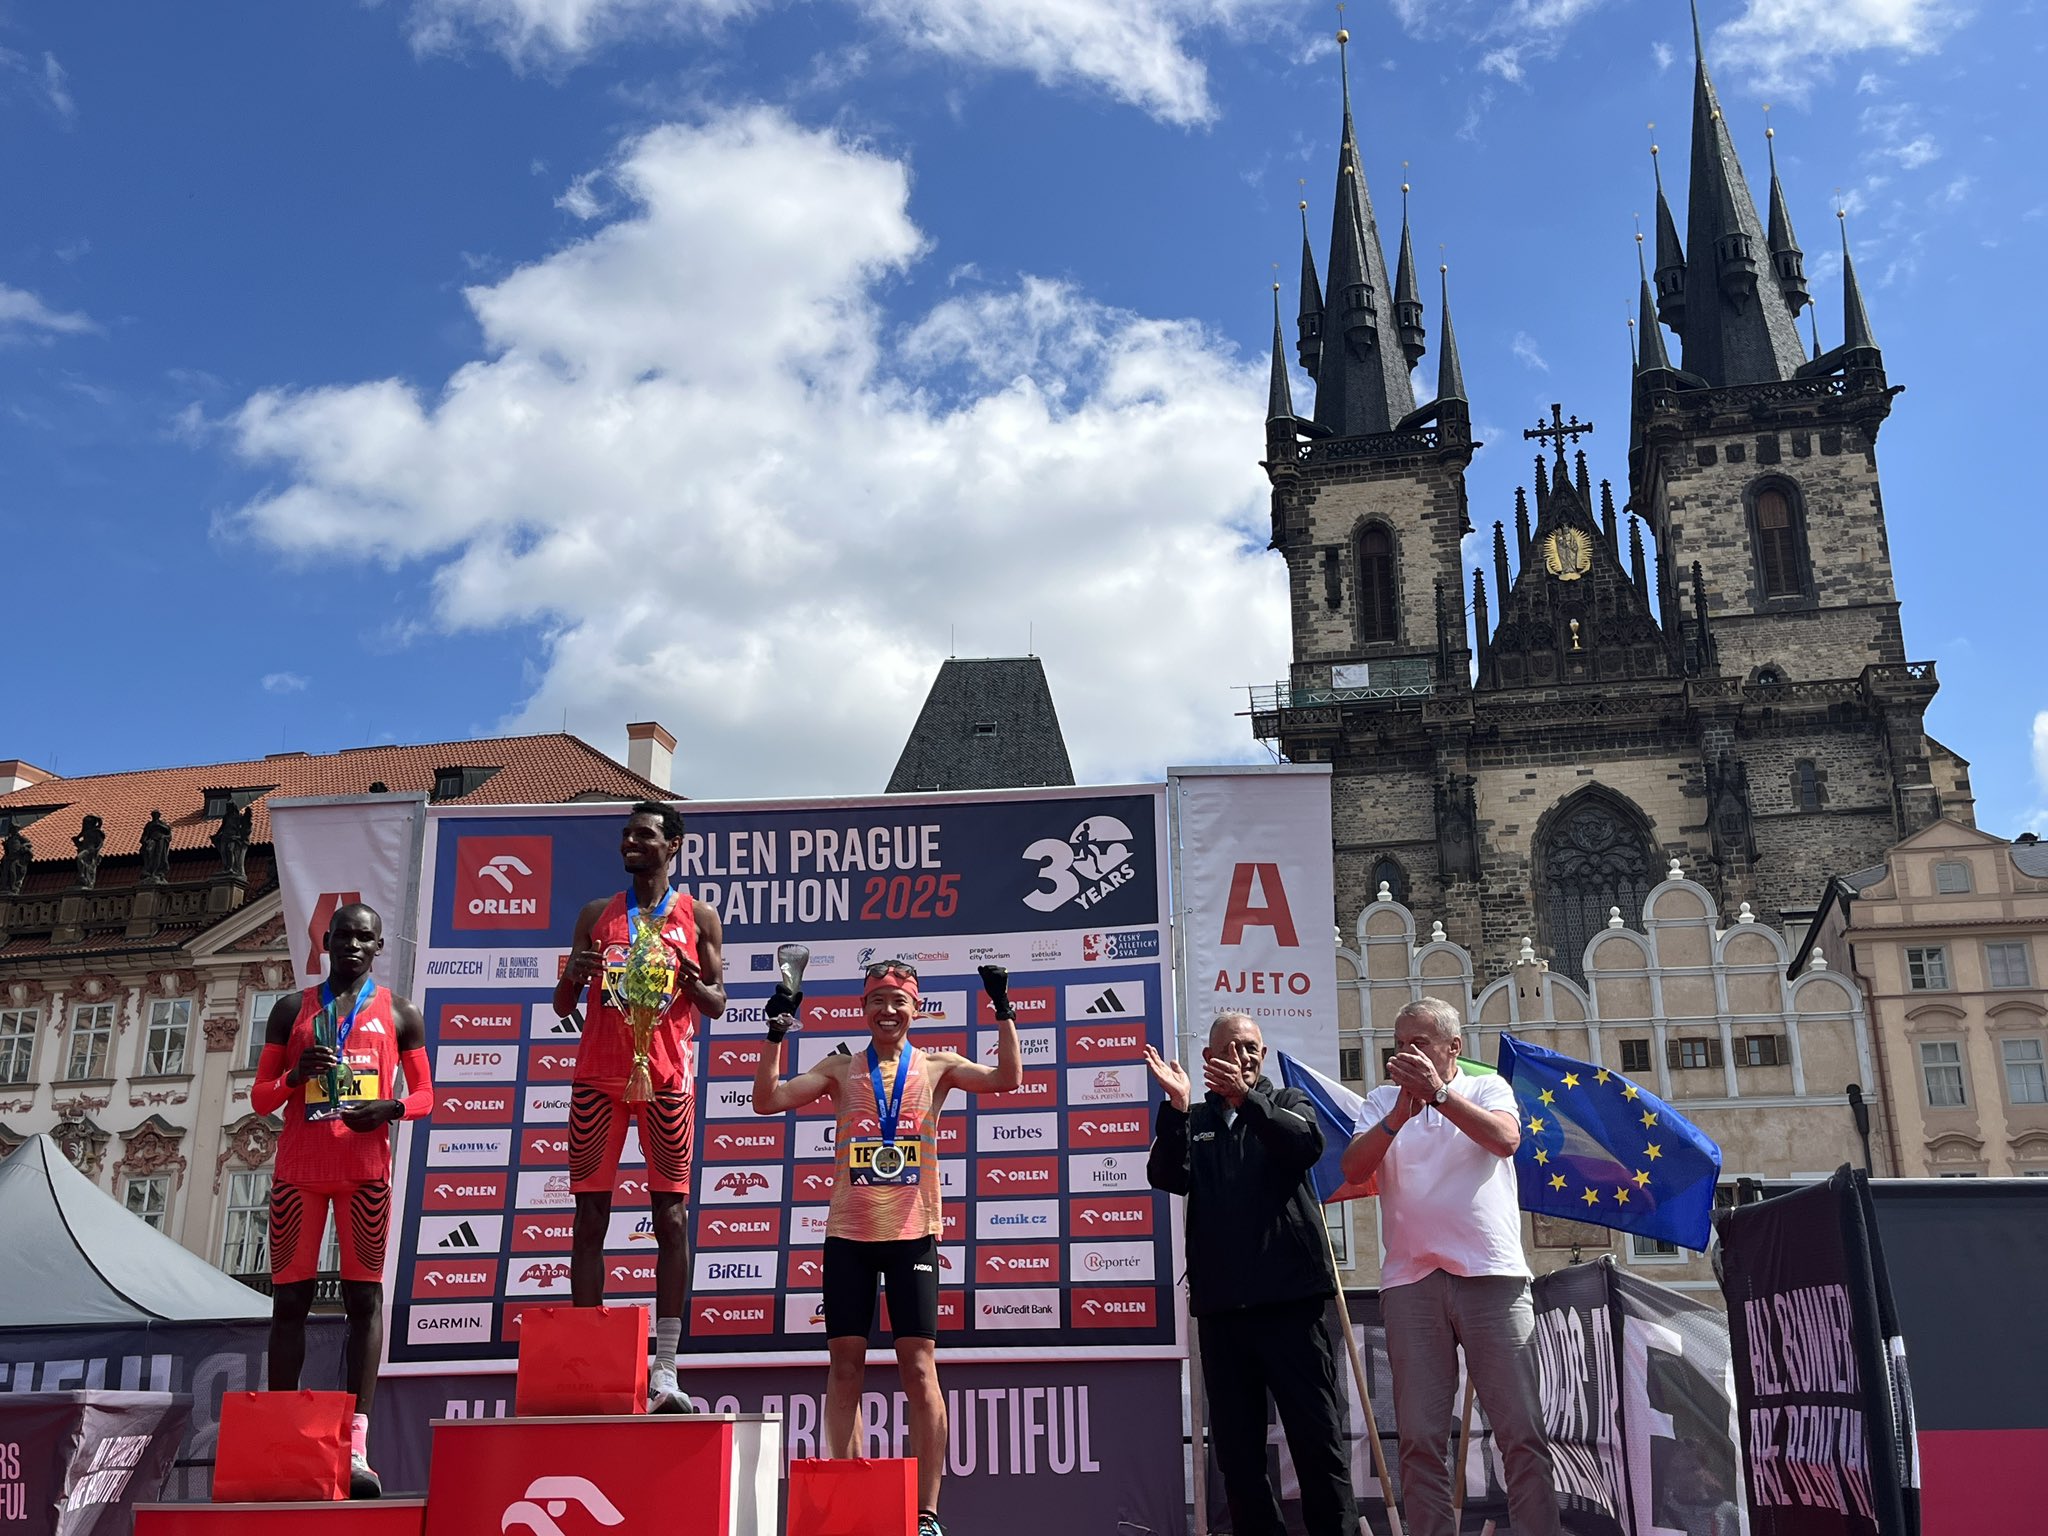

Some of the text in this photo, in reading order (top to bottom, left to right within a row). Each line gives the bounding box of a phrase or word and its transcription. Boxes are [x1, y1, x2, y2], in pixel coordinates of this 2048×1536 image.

[668, 824, 941, 877] RLEN PRAGUE
[1074, 863, 1136, 911] YEARS
[677, 873, 961, 925] RATHON 2025
[1220, 863, 1300, 947] A
[468, 898, 537, 915] ORLEN
[896, 952, 949, 961] #VisitCzechia
[969, 946, 993, 955] prague
[499, 957, 538, 967] ALL RUNNERS
[969, 953, 983, 961] city
[427, 961, 483, 975] RUNCZECH
[496, 967, 540, 979] ARE BEAUTIFUL
[1214, 970, 1311, 995] AJETO
[920, 998, 942, 1011] dm
[726, 1008, 768, 1023] BiREL
[830, 1008, 863, 1018] ORLE
[1257, 1008, 1312, 1018] EDITIONS
[471, 1016, 512, 1028] ORLEN
[1020, 1038, 1049, 1047] rague
[1097, 1036, 1137, 1048] ORLEN
[1020, 1046, 1049, 1055] irport
[453, 1053, 502, 1066] AJETO
[464, 1100, 505, 1111] ORLEN
[992, 1125, 1043, 1140] Forbes
[1100, 1121, 1140, 1133] ORLEN
[451, 1142, 499, 1152] KOMWAG
[735, 1136, 775, 1147] ORLEN
[1008, 1169, 1049, 1181] ORLEN
[1092, 1169, 1127, 1182] Hilton
[722, 1177, 764, 1186] MATTONI
[455, 1185, 497, 1197] ORLEN
[990, 1212, 1047, 1226] deník.cz
[1102, 1210, 1143, 1222] ORLEN
[544, 1226, 573, 1238] ORLE
[730, 1221, 771, 1233] ORLEN
[913, 1263, 933, 1273] HOKA
[1008, 1257, 1049, 1269] ORLEN
[1089, 1255, 1141, 1269] Reportér
[526, 1268, 569, 1279] MATTONI
[708, 1263, 763, 1280] BiRELL
[445, 1272, 487, 1284] ORLEN
[992, 1303, 1053, 1316] UniCredit Bank
[1104, 1302, 1146, 1313] ORLEN
[723, 1309, 764, 1321] ORLEN
[417, 1316, 481, 1330] GARMIN
[862, 1385, 1100, 1477] BEUTIFUL
